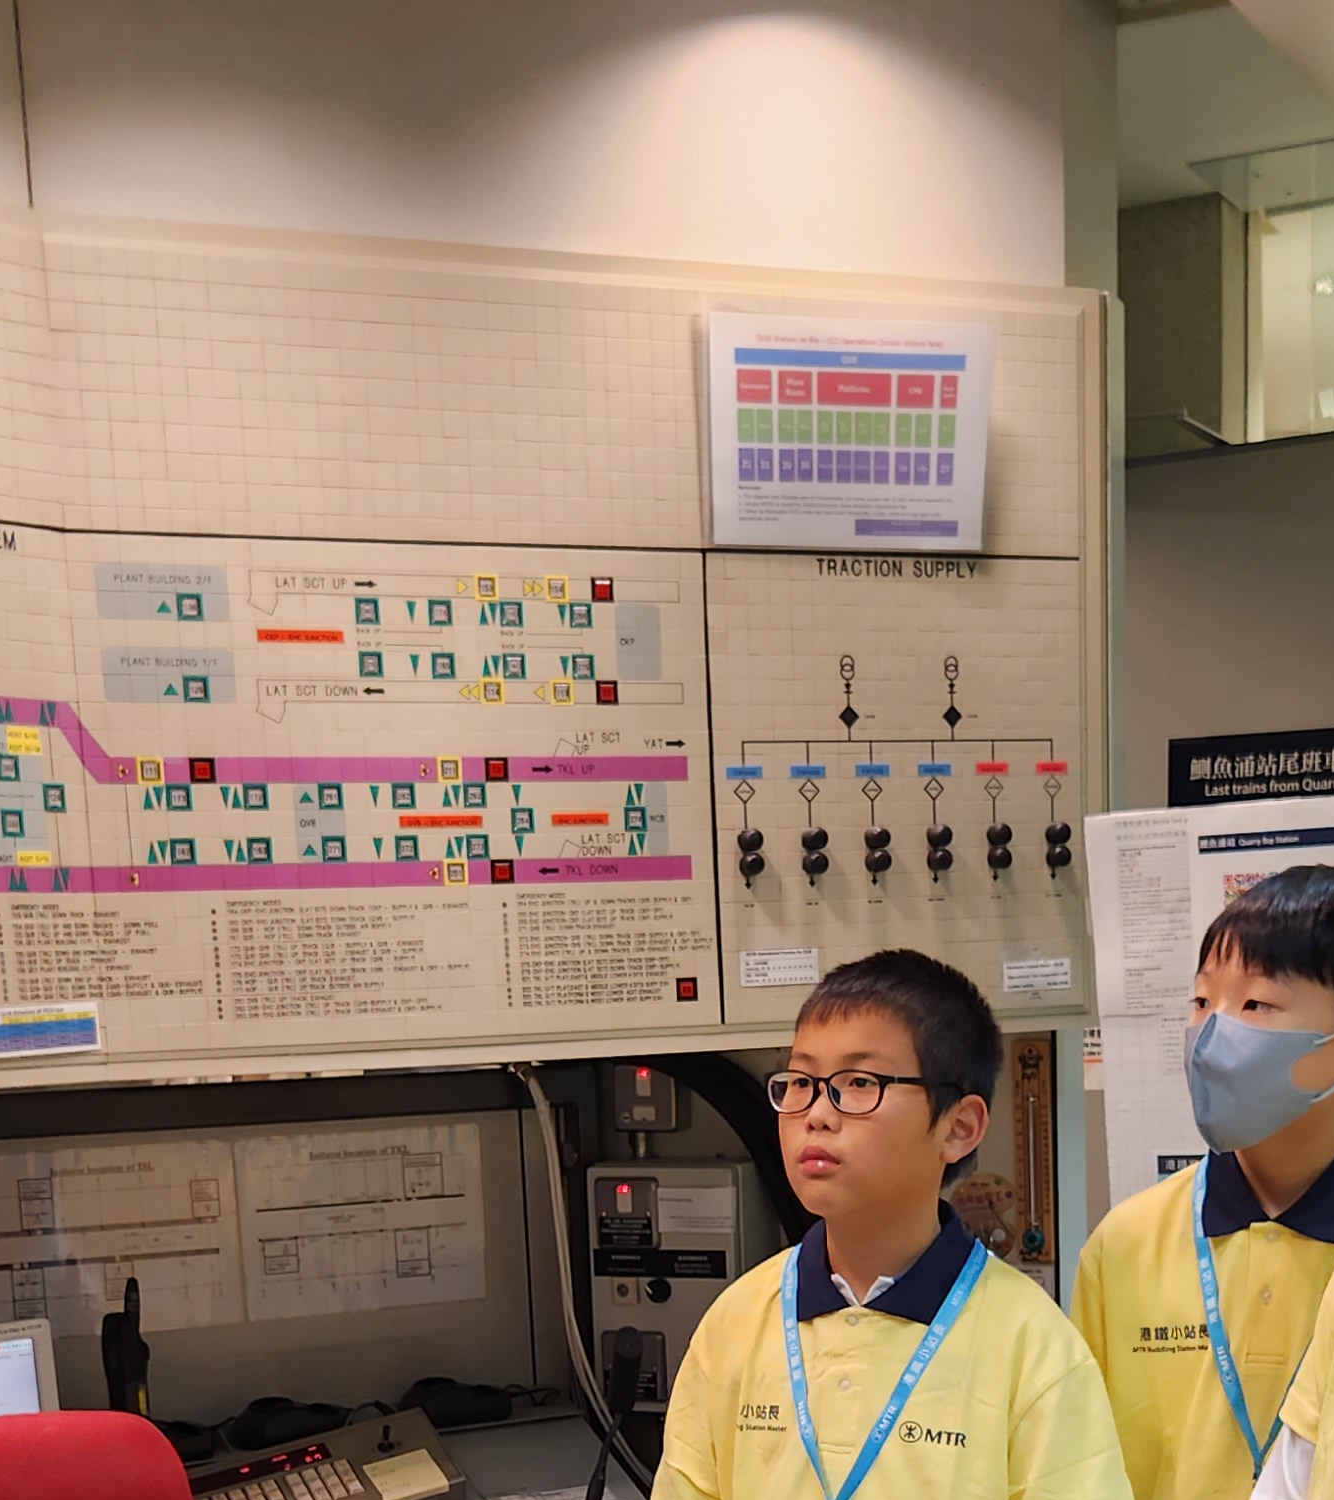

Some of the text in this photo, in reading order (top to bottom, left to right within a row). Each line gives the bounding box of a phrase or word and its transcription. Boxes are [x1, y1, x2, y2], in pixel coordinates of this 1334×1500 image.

[816, 558, 977, 579] TRACTION SUPPLY
[113, 573, 213, 586] PLANT BUILDING 2/F
[275, 577, 348, 590] LAT SCT UP
[121, 657, 218, 668] PLANT BUILDING 1/F
[266, 685, 358, 698] LAT SCT DOWN
[574, 732, 621, 743] LAT SCT
[643, 738, 664, 749] YAT
[557, 764, 596, 775] TKL UP
[1204, 783, 1230, 797] Last
[1232, 780, 1267, 795] trains
[1269, 777, 1299, 792] from
[581, 833, 626, 845] LAT SCT
[581, 846, 612, 857] DOWN
[565, 865, 619, 876] TKL DOWN
[740, 1403, 780, 1421] 小站長
[878, 1404, 898, 1431] MTR
[745, 1423, 787, 1433] Station Master
[924, 1428, 967, 1448] MTR
